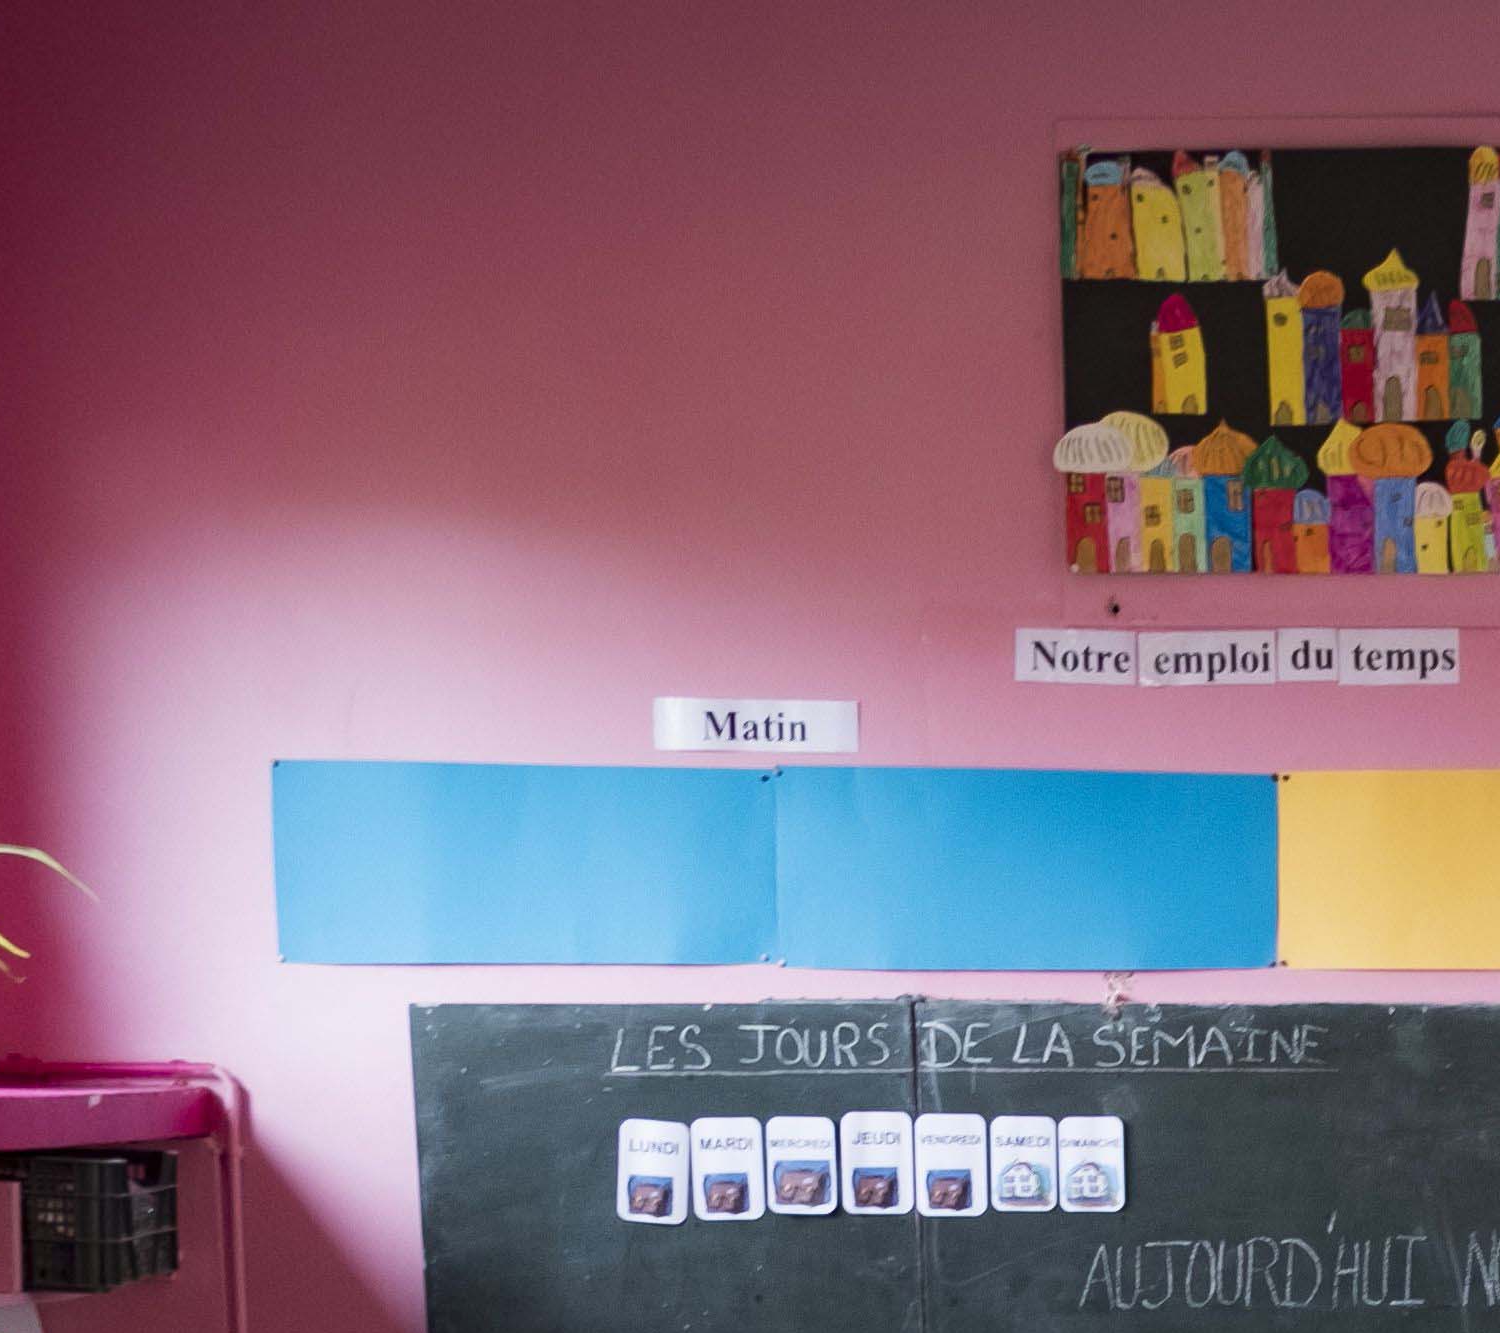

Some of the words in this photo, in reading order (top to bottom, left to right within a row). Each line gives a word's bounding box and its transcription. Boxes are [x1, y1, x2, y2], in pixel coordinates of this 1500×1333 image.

[1031, 640, 1131, 673] Notre
[1153, 641, 1271, 682] emploi
[1291, 640, 1333, 671] du
[1353, 642, 1456, 680] temps
[703, 710, 807, 742] Matin
[611, 1024, 711, 1072] LES
[738, 1021, 889, 1067] JOURS
[921, 1021, 993, 1068] DE
[1012, 1022, 1074, 1067] LA
[1092, 1022, 1329, 1068] SEMAINE
[628, 1138, 679, 1155] LUNDI
[700, 1137, 753, 1151] MARDI
[851, 1131, 901, 1146] JEUDI
[995, 1135, 1049, 1148] SAMEDI
[1079, 1211, 1427, 1311] AUJOURD'HUI
